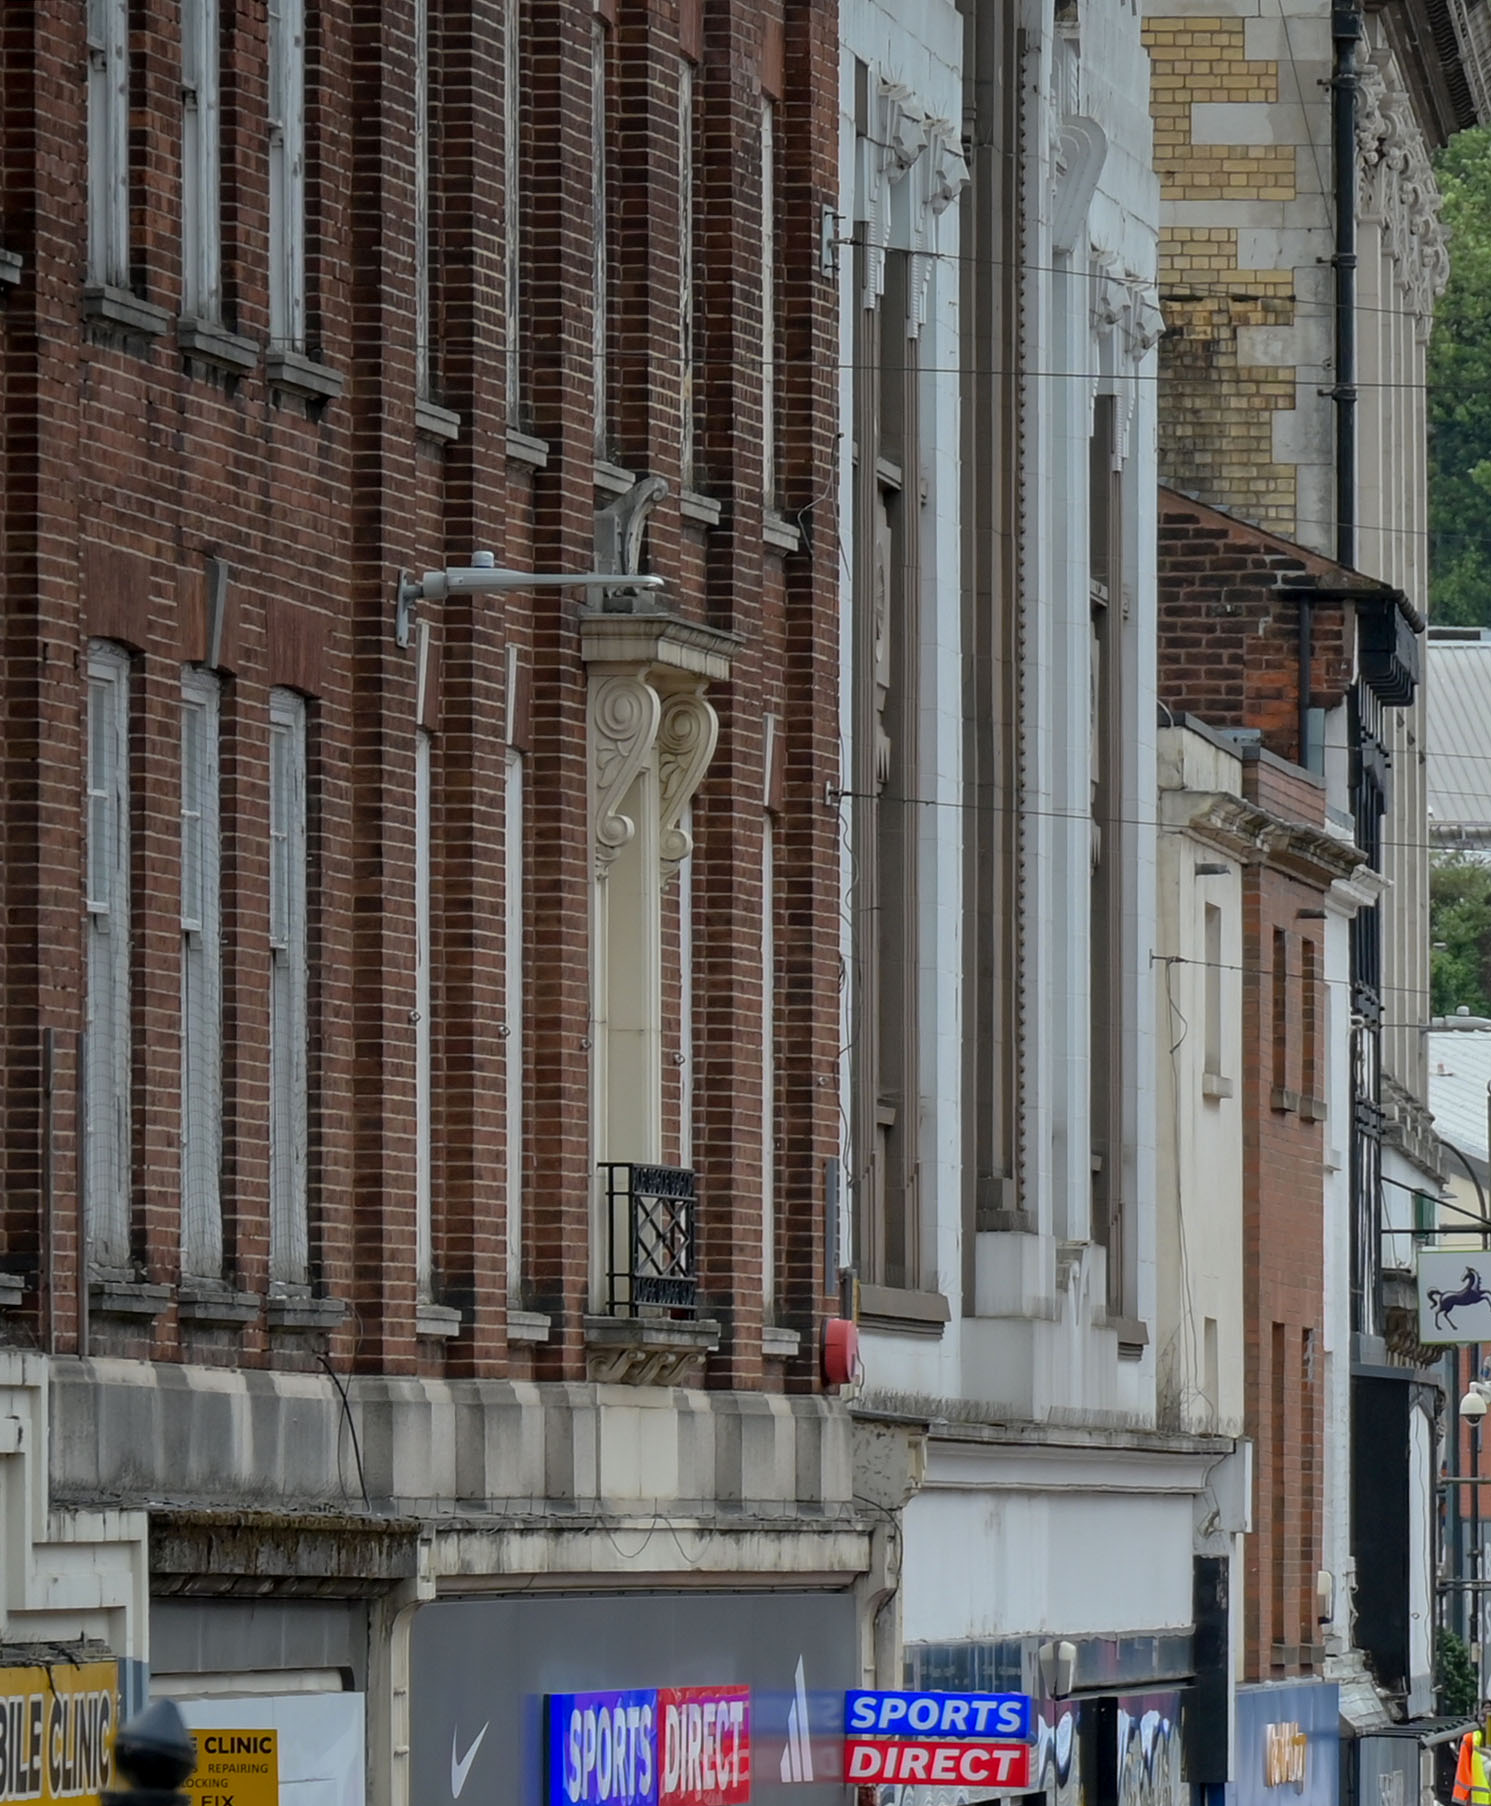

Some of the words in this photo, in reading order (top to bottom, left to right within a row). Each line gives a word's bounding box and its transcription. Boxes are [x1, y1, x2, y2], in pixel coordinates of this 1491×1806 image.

[850, 1697, 1022, 1732] SPORTS
[50, 1689, 111, 1799] CLINIC
[204, 1737, 272, 1754] CLINIC
[569, 1703, 652, 1803] SPORTS
[665, 1700, 743, 1794] DIRECT
[208, 1764, 269, 1774] REPAIRING
[848, 1747, 1021, 1780] DIRECT
